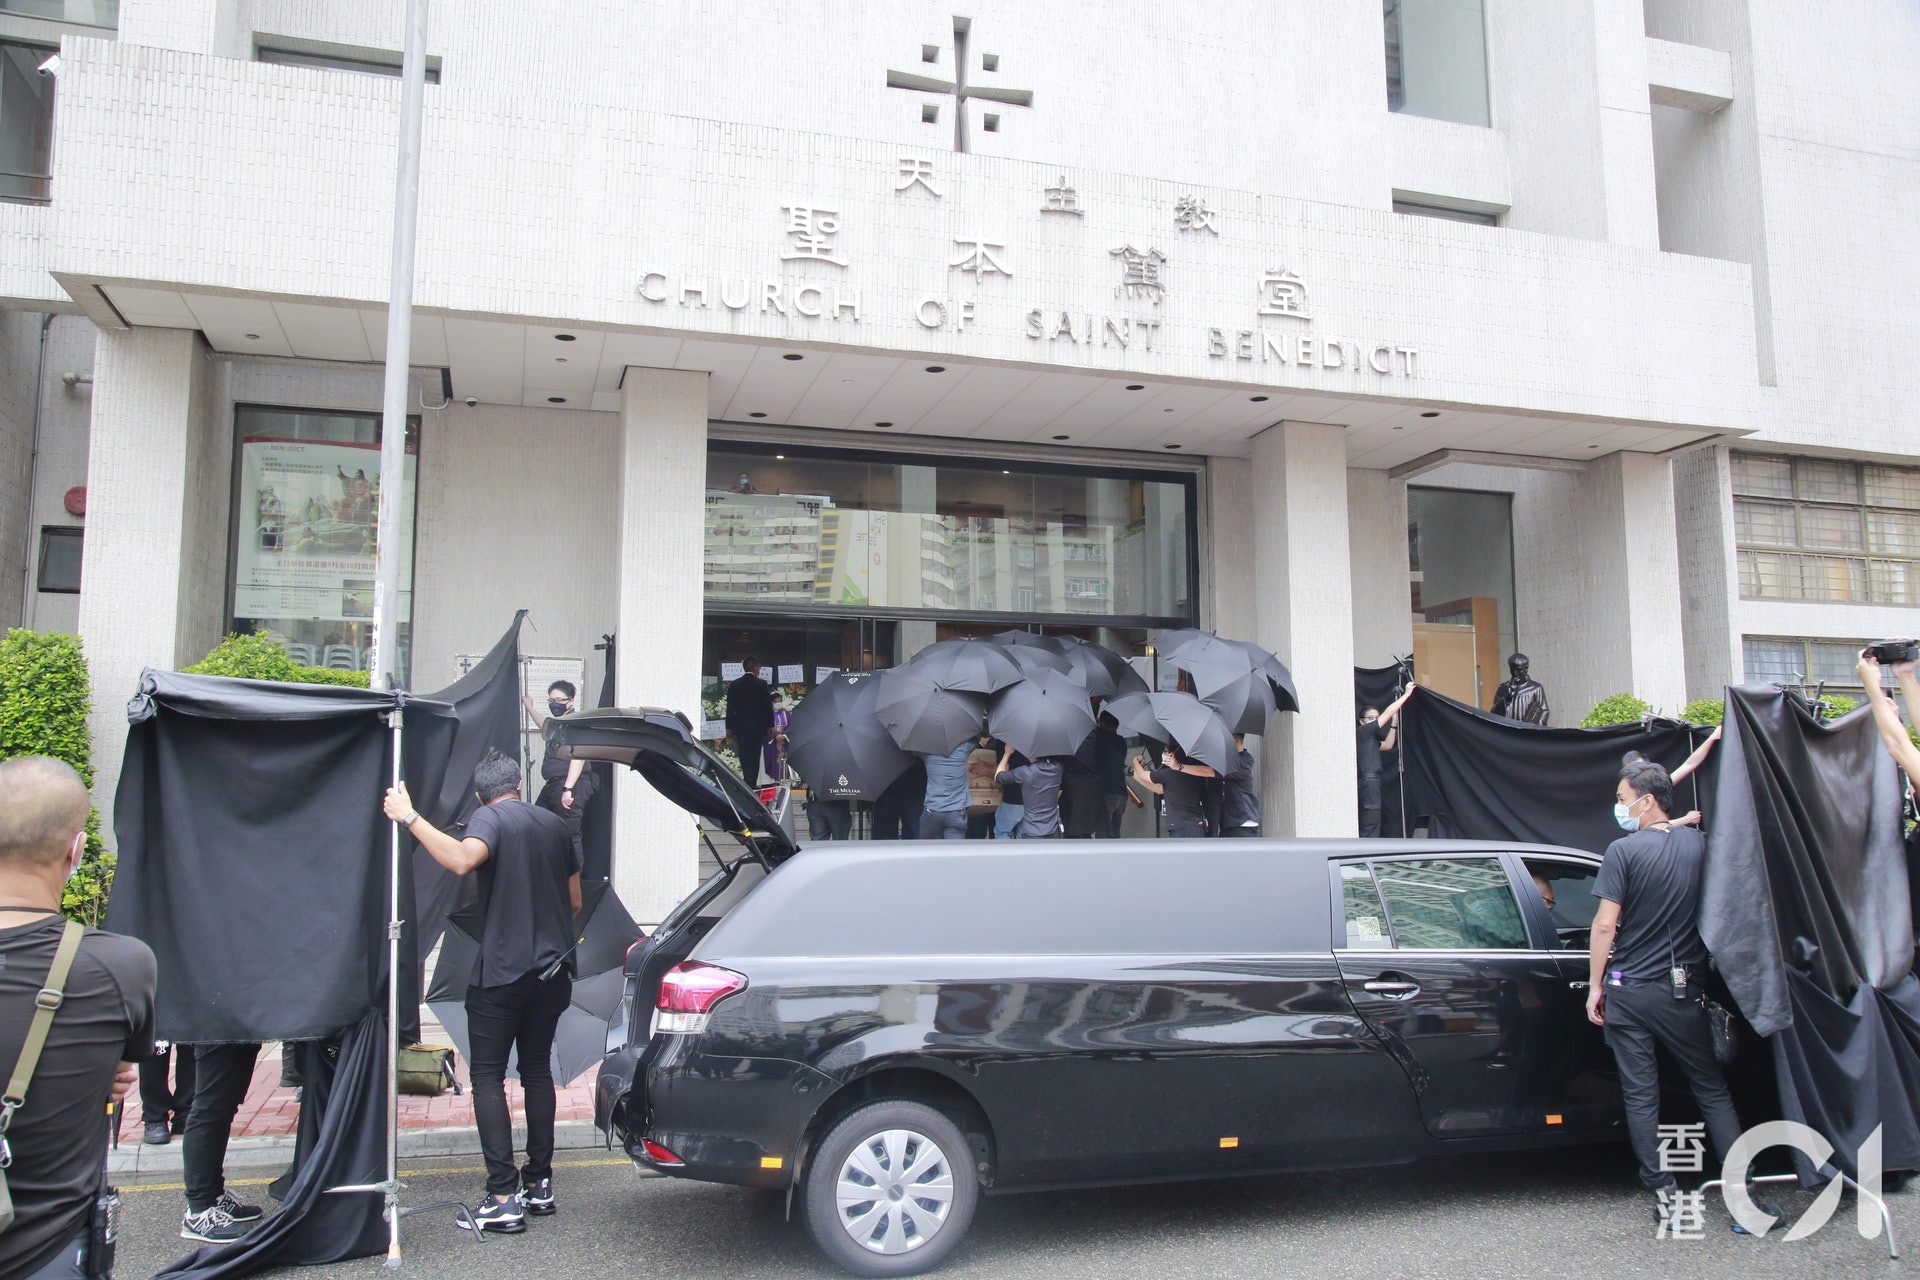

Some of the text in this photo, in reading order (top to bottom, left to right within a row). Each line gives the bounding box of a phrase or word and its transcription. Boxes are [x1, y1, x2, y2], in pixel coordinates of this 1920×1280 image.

[894, 157, 1219, 236] 天主教
[780, 204, 1312, 321] 聖本篤堂
[637, 271, 1419, 376] CHURCH OF SAINT BENEDICT
